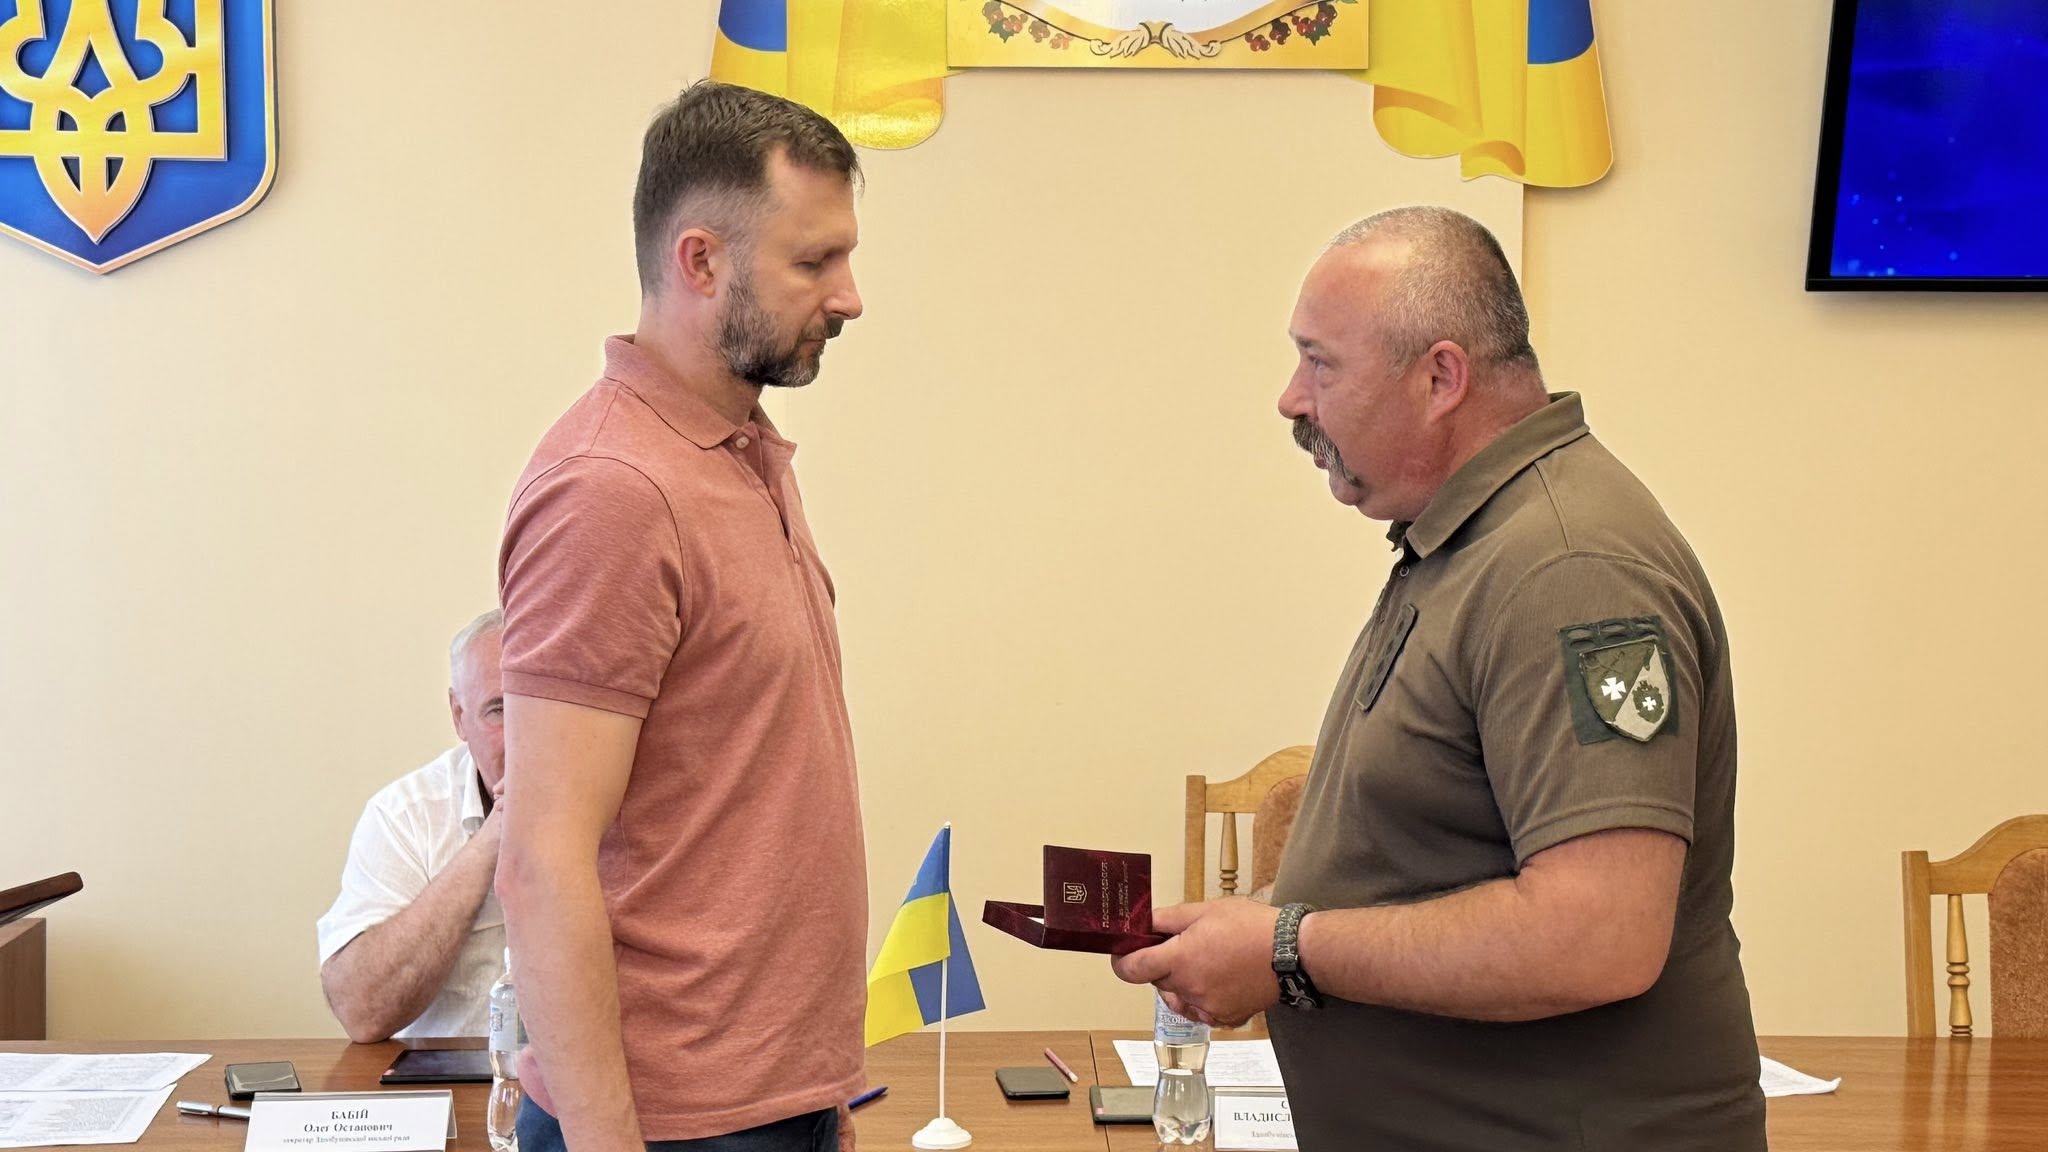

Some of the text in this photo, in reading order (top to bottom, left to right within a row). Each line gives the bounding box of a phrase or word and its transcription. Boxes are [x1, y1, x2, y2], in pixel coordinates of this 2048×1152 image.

[331, 1108, 369, 1119] БАБІЙ
[1234, 1112, 1291, 1122] ВЛАДИСЛ
[304, 1123, 393, 1132] Олег Остапович
